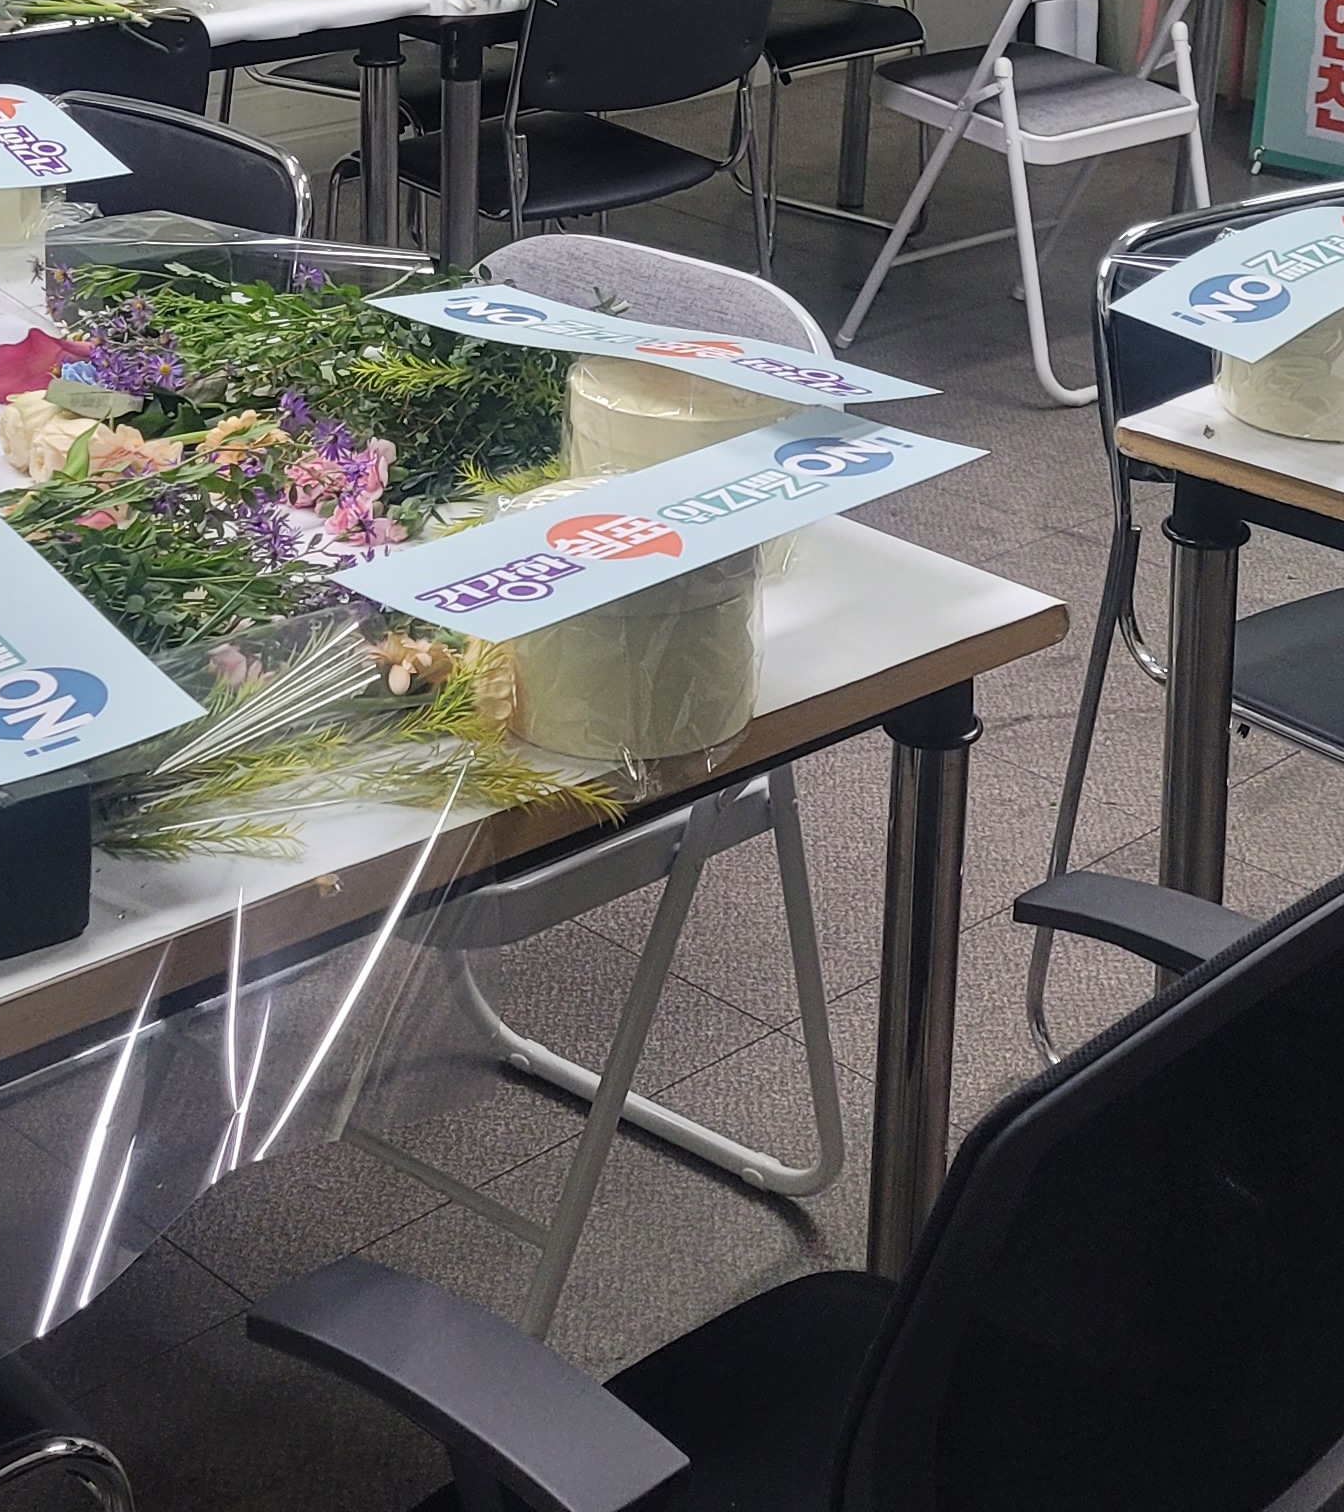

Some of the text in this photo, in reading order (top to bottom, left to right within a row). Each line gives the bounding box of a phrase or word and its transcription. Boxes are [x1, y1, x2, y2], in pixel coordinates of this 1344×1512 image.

[1173, 273, 1283, 327] ON!
[732, 356, 873, 397] 건강한
[414, 437, 914, 614] 건강한 쉼표 워라밸 ON!
